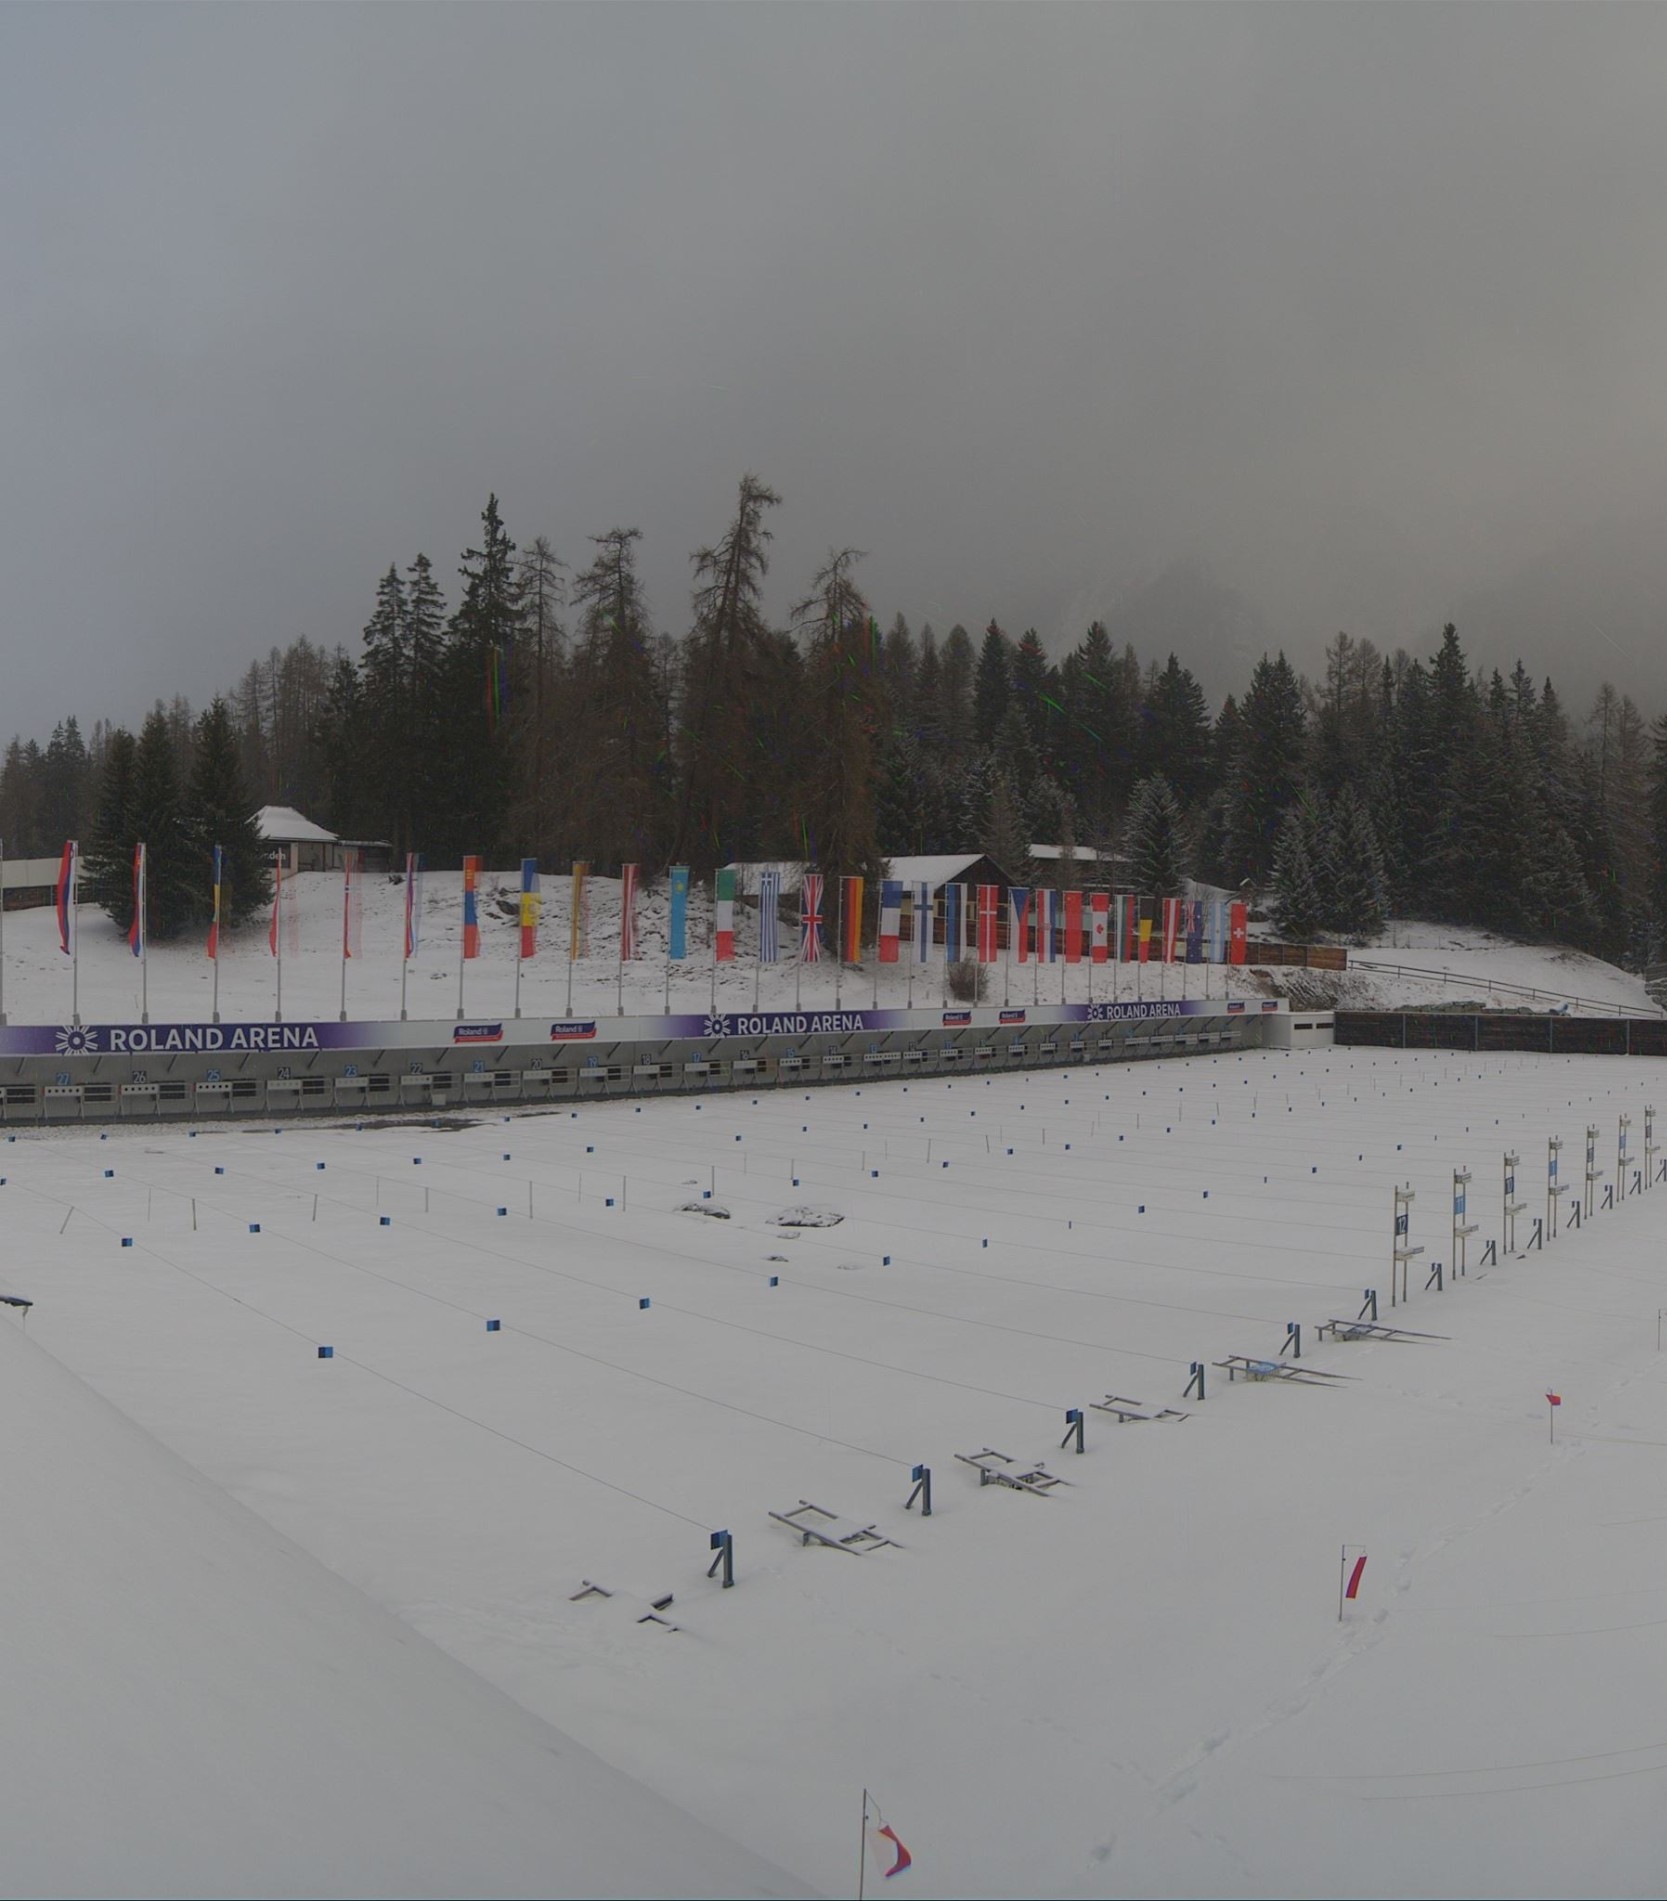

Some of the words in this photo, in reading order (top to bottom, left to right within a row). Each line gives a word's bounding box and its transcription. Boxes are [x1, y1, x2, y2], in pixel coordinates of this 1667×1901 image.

[1106, 1002, 1148, 1019] ROLAND
[1150, 1002, 1181, 1017] ARENA
[458, 1027, 482, 1036] Roland
[556, 1025, 578, 1033] Roland
[737, 1016, 807, 1035] ROLAND
[810, 1015, 864, 1032] ARENA
[110, 1028, 223, 1051] ROLAND
[230, 1026, 319, 1049] ARENA
[207, 1068, 220, 1082] 25
[277, 1067, 290, 1080] 24
[345, 1065, 357, 1077] 23
[410, 1063, 423, 1075] 22
[57, 1073, 69, 1086] 27
[133, 1071, 146, 1084] 26
